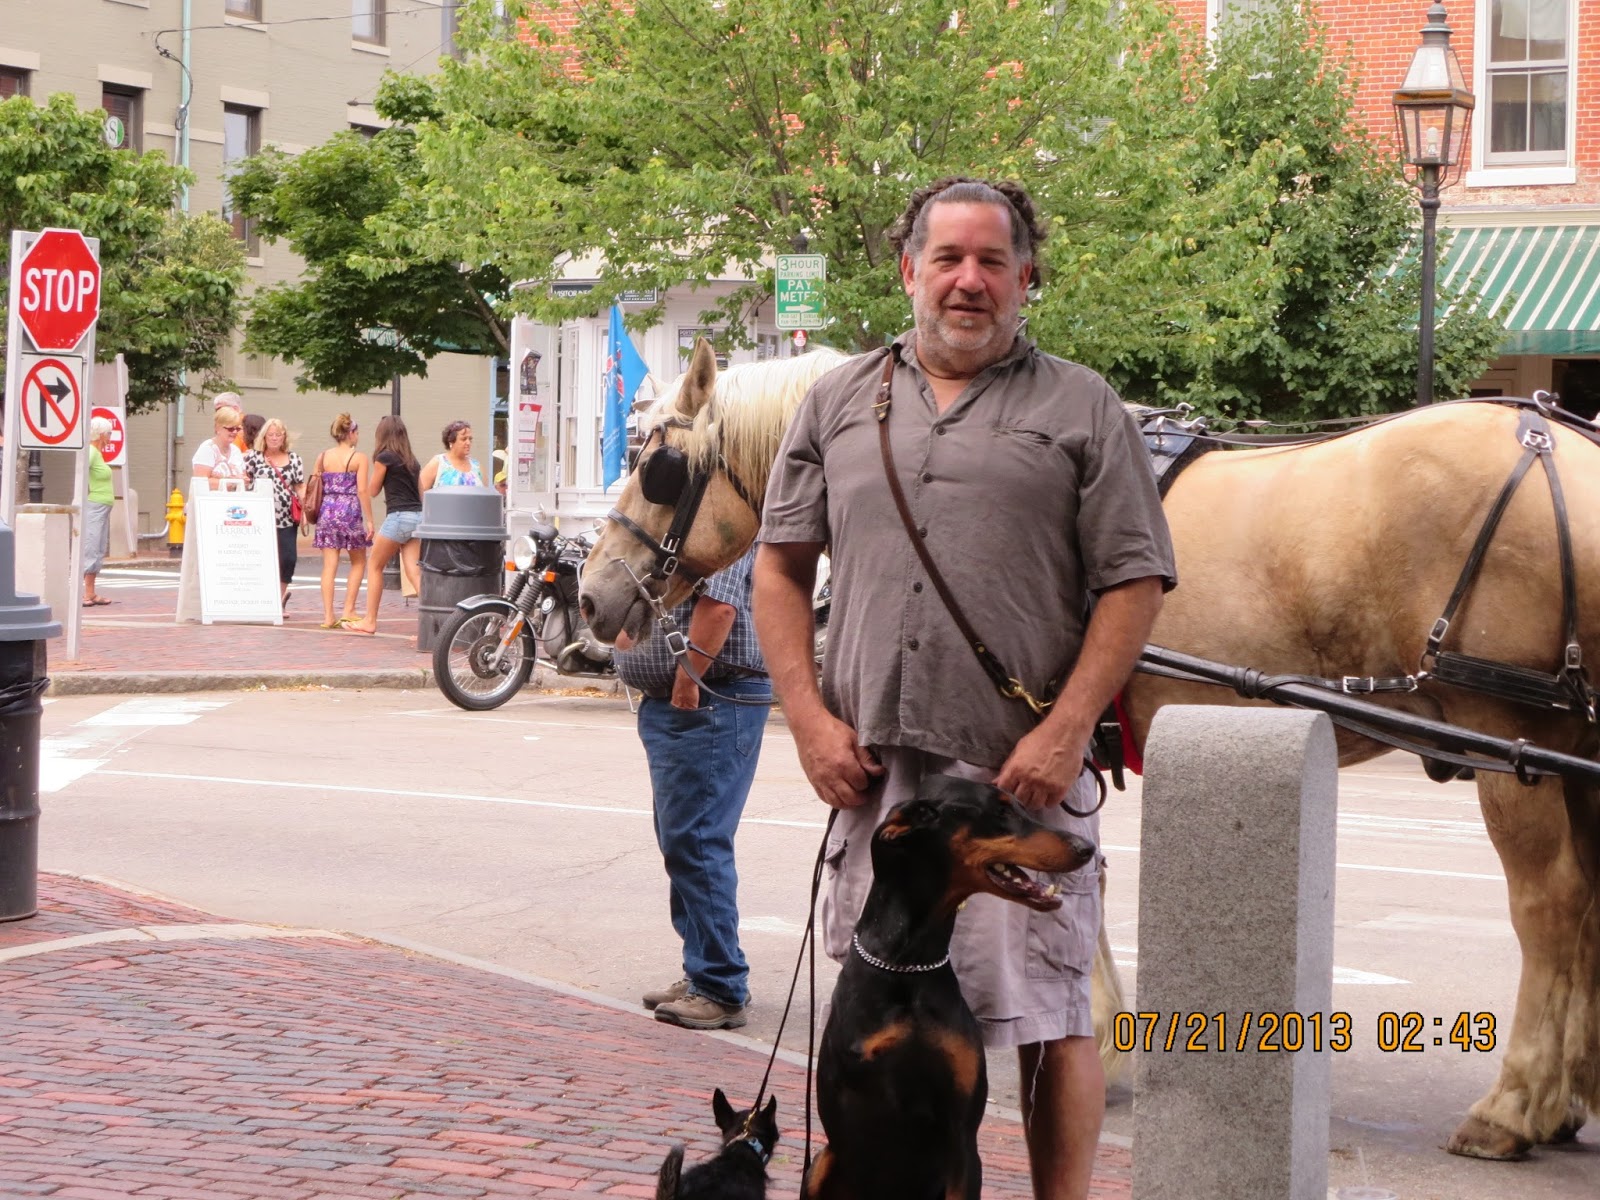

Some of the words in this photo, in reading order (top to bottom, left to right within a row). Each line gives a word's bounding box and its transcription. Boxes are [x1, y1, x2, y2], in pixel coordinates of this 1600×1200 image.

[780, 258, 789, 271] 3
[790, 260, 819, 269] HOUR
[23, 267, 95, 312] STOP
[788, 280, 812, 291] PAY
[215, 525, 262, 535] HARBOUR
